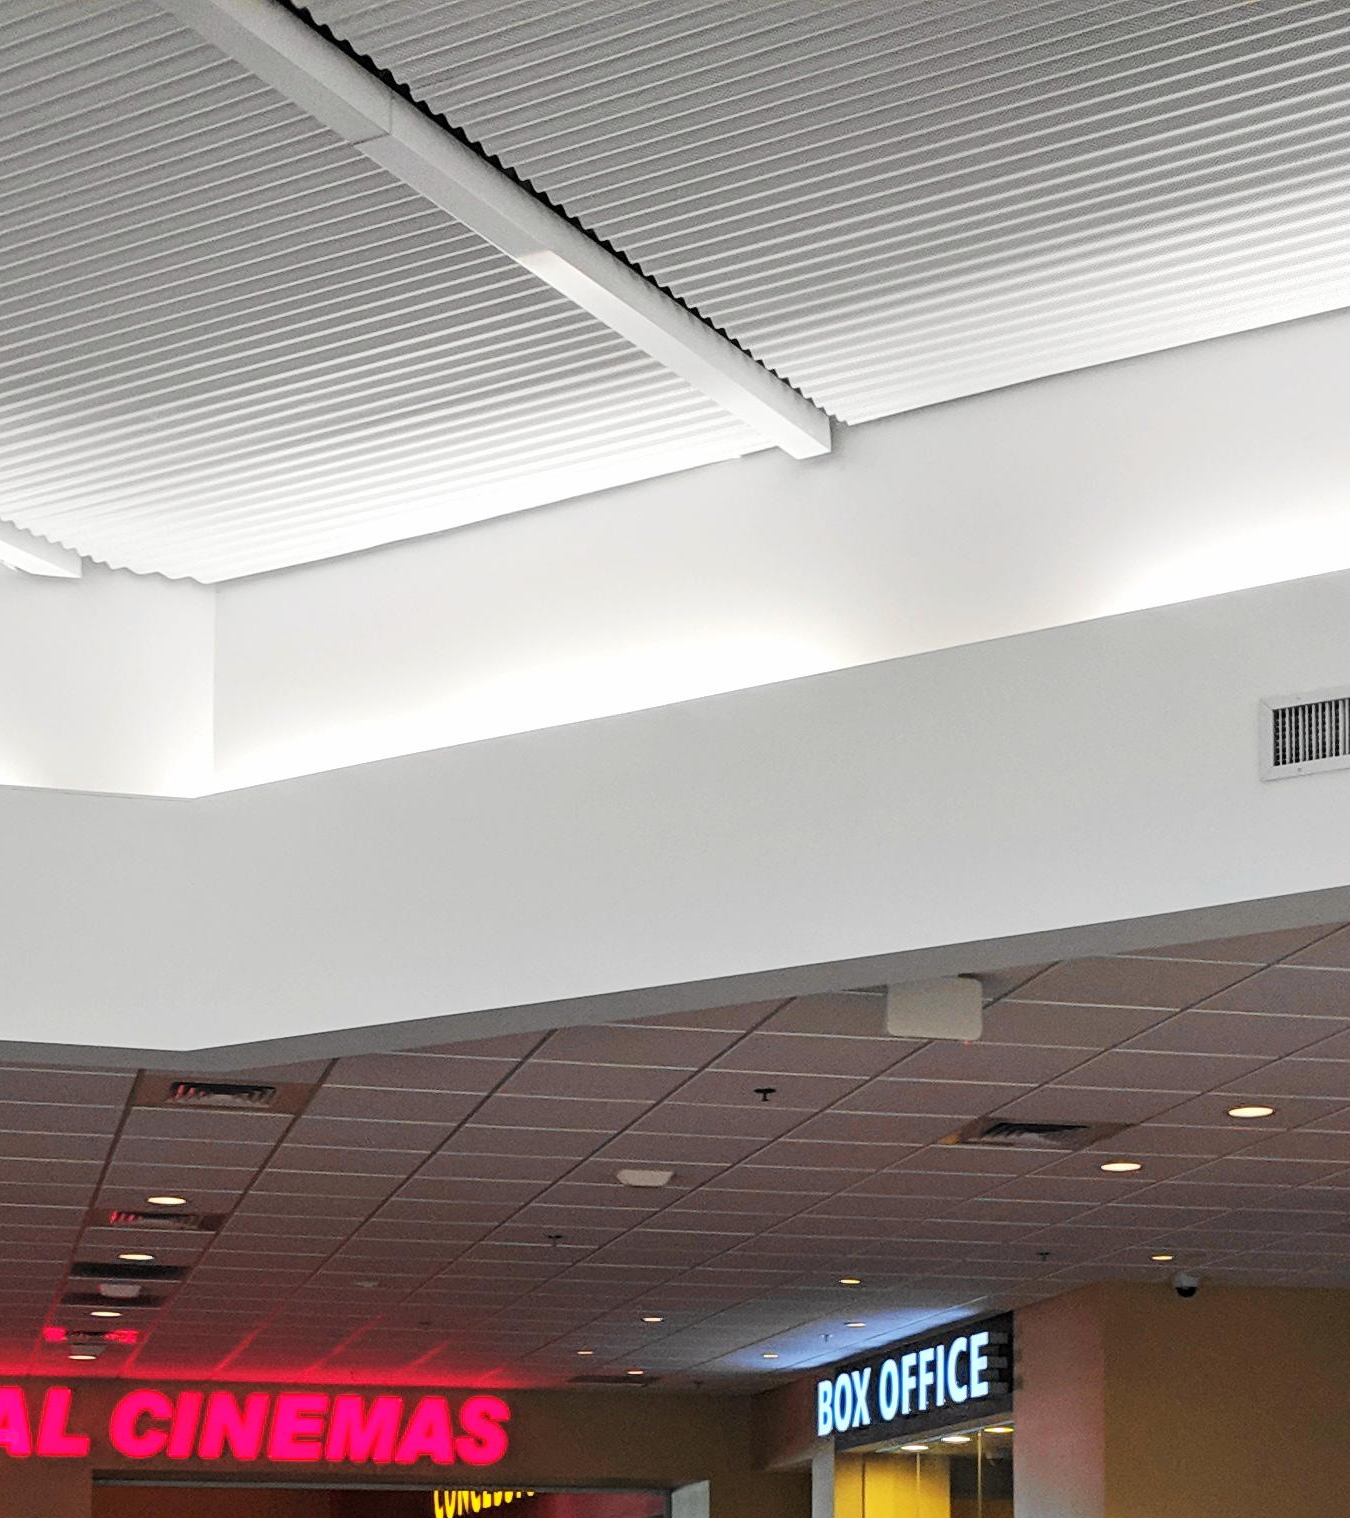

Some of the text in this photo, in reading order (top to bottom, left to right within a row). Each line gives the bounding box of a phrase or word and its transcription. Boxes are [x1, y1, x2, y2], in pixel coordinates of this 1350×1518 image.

[109, 1388, 512, 1466] CINEMAS
[817, 1331, 989, 1437] BOX OFFICE
